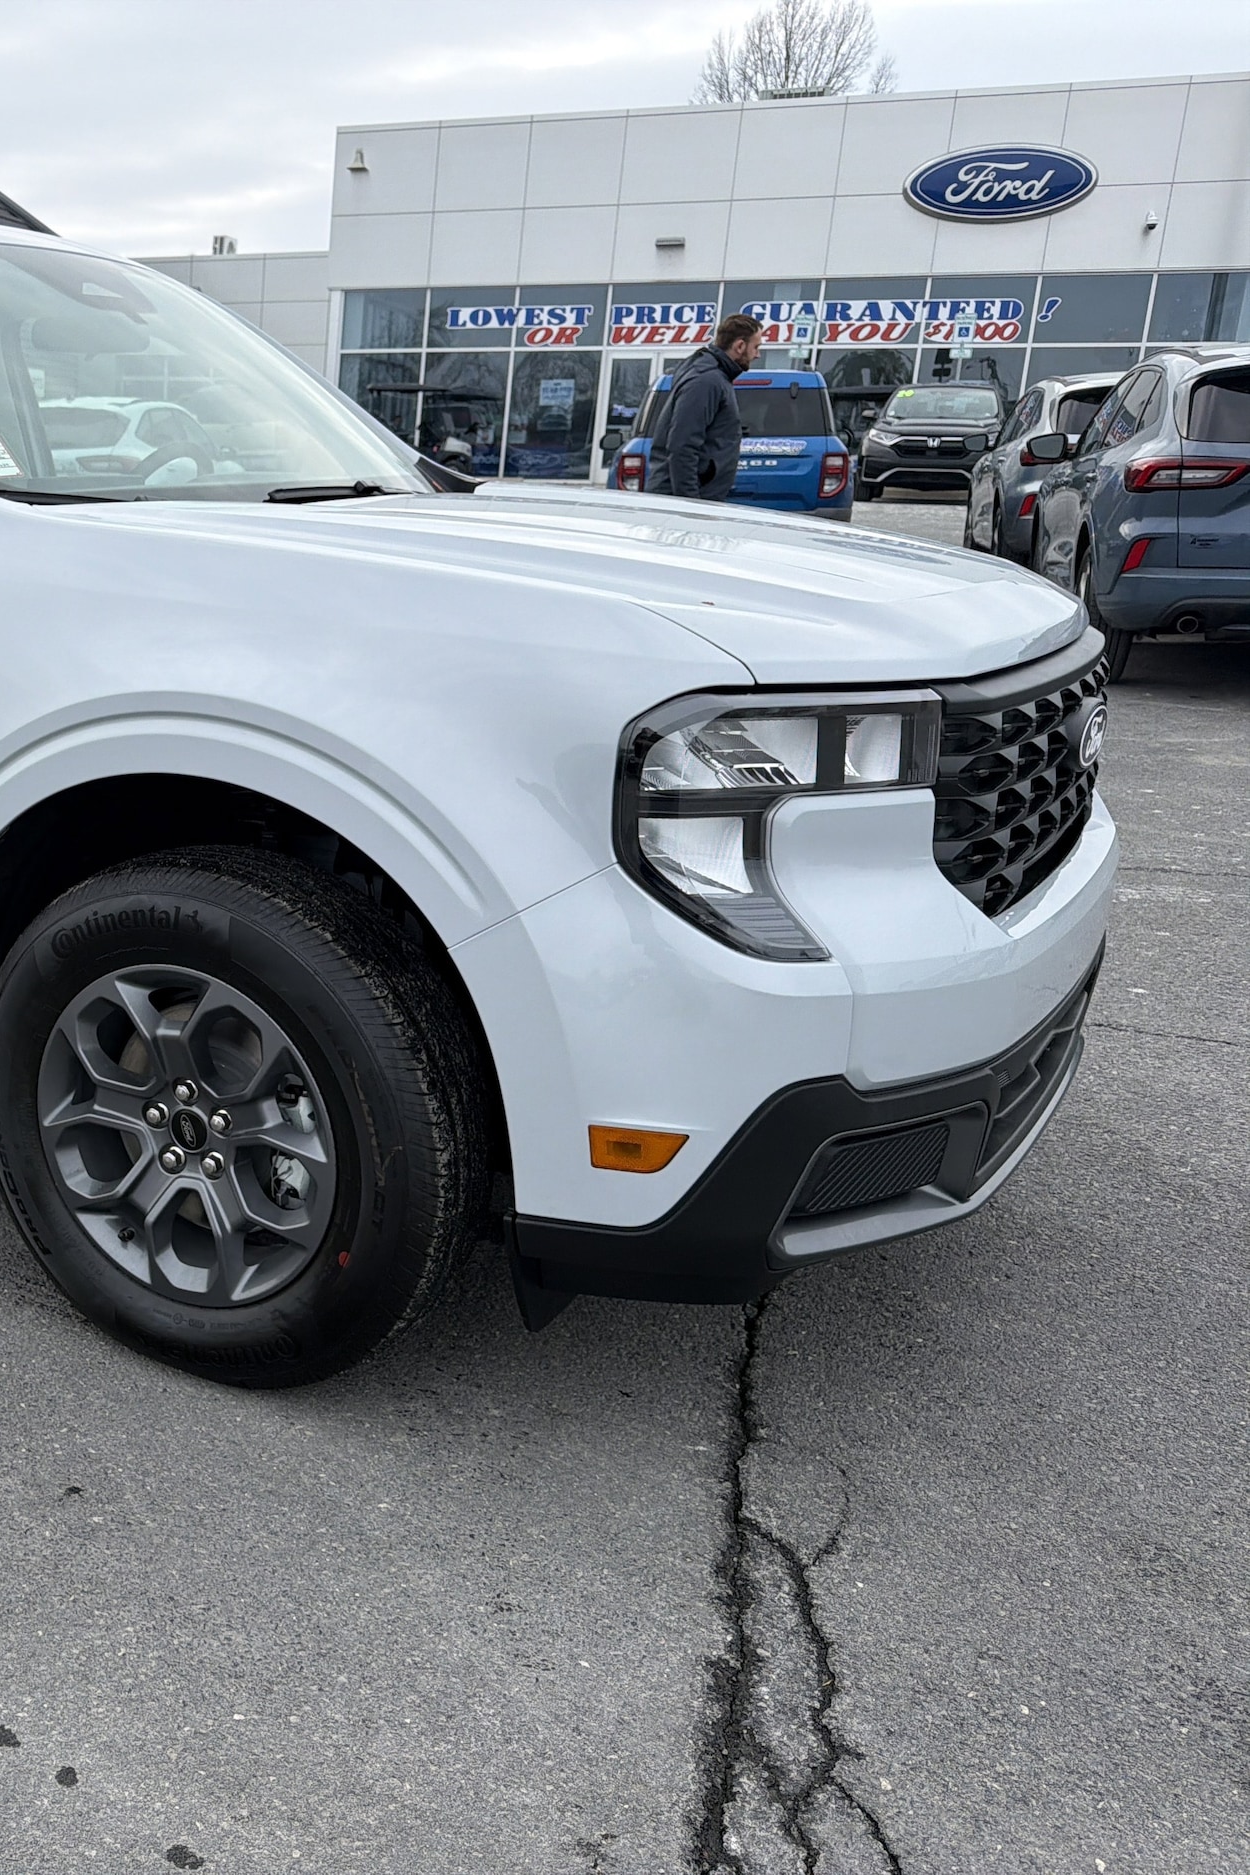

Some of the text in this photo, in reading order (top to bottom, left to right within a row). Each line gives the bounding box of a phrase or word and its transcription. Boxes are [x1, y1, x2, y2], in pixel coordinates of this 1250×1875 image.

[945, 161, 1056, 204] Ford
[449, 306, 592, 328] LOWEST
[612, 304, 716, 325] PRICE
[741, 301, 1022, 322] GUARANTEED
[526, 326, 582, 345] OR
[824, 322, 915, 343] YOU
[924, 321, 1021, 342] $100
[51, 904, 184, 961] Continental
